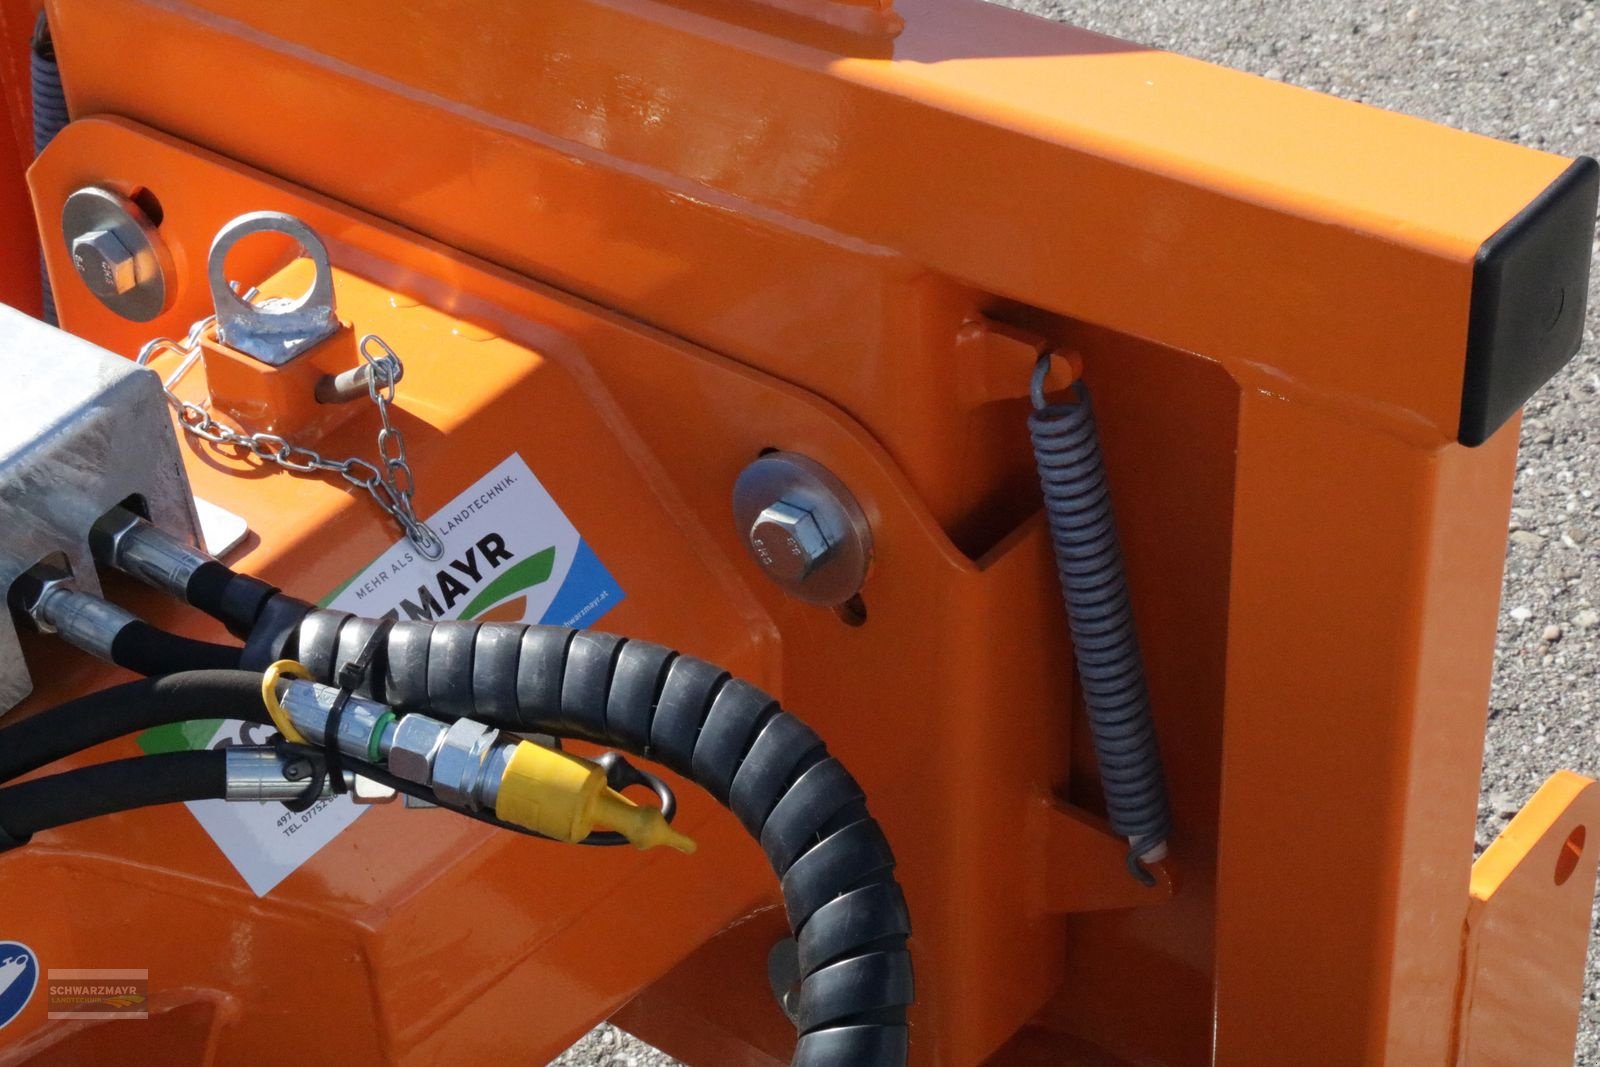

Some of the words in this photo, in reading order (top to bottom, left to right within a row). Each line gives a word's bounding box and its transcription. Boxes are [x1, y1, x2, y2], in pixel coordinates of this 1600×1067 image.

[355, 567, 389, 599] MEHR
[392, 552, 414, 575] ALS
[440, 476, 518, 536] LANDTECHNIK.
